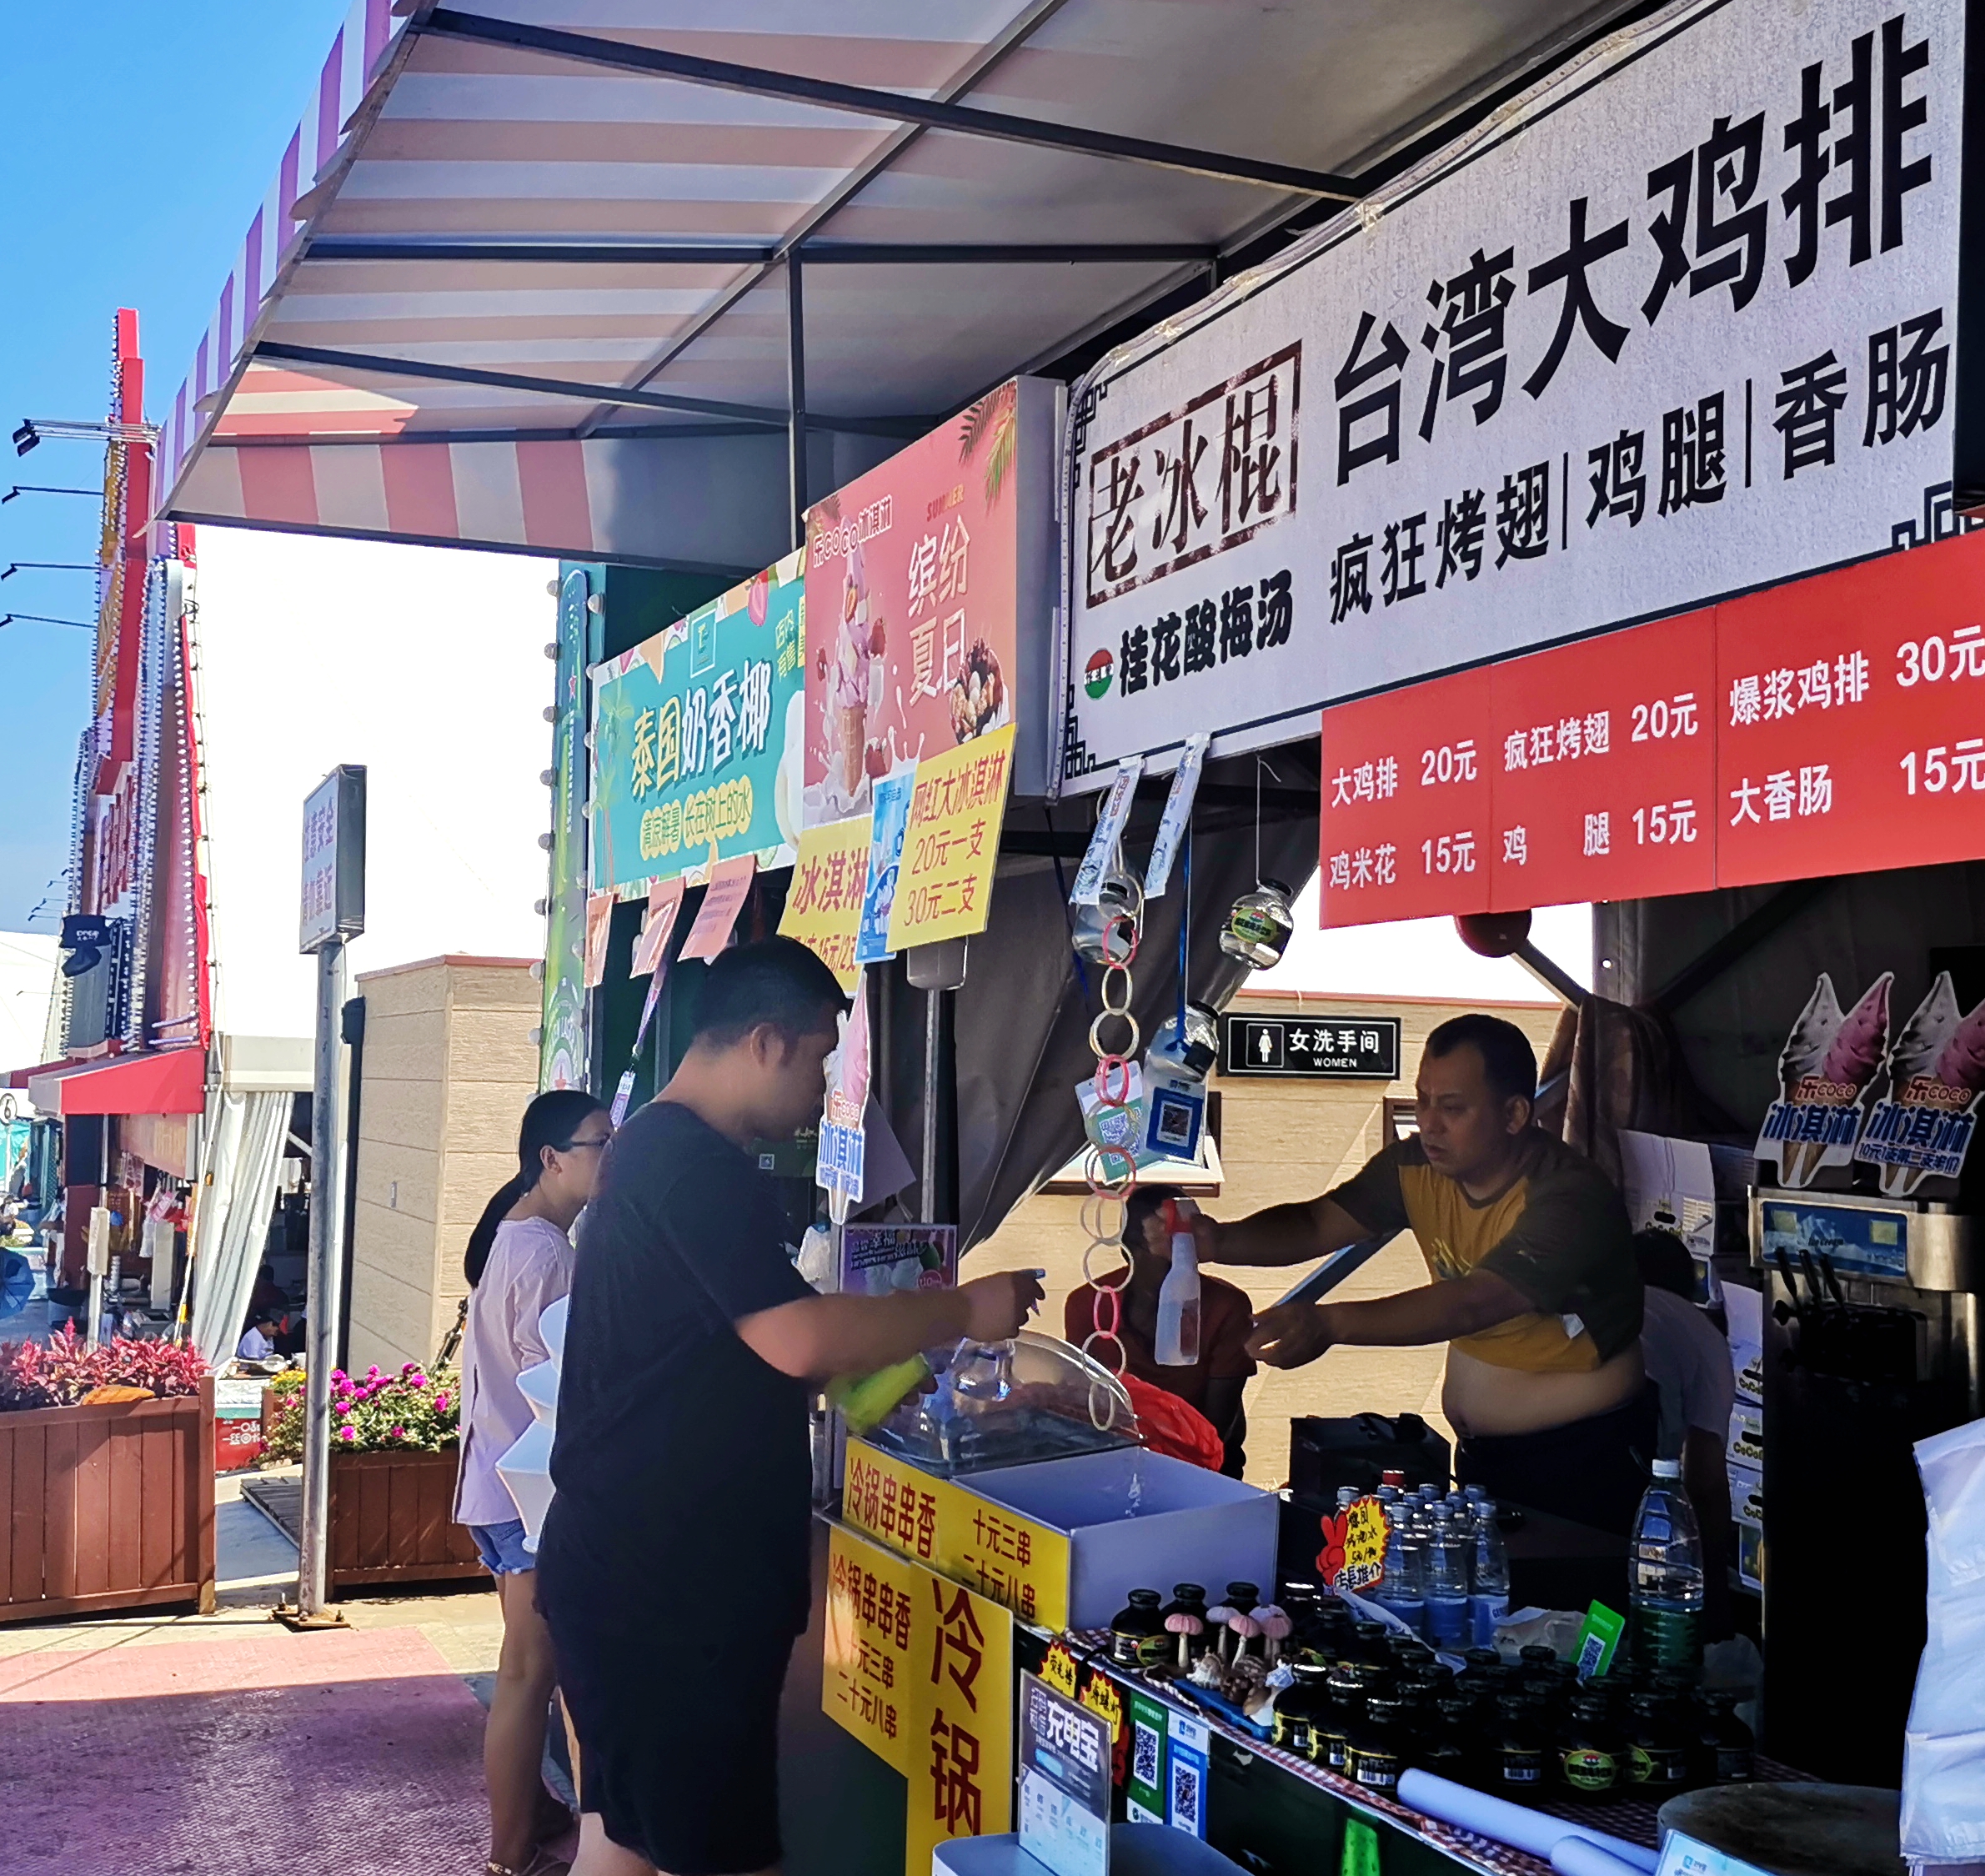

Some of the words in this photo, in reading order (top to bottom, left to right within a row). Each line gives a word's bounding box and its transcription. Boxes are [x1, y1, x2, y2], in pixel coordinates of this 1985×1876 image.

[1333, 13, 1932, 487] 台湾大鸡排
[1091, 373, 1281, 584] 老冰棍
[1330, 461, 1549, 623] 疯狂烤翅
[1587, 392, 1725, 529] 鸡腿
[1773, 308, 1949, 479] 香肠
[908, 514, 970, 618] 缤纷
[910, 608, 965, 708] 夏日
[1118, 569, 1292, 697] 桂花酸梅汤
[1729, 650, 1869, 727] 爆浆鸡排
[1896, 625, 1985, 688] 30元
[631, 660, 771, 798] 泰国奶香椰
[1504, 711, 1610, 772] 疯狂烤翅
[1631, 692, 1698, 743] 20元
[909, 749, 1006, 831] 网红大冰淇淋
[1331, 757, 1398, 807] 大鸡排
[1421, 740, 1477, 786] 20元
[1729, 763, 1832, 827] 大香肠
[1899, 738, 1985, 796] 15元
[911, 818, 987, 875] 20元一支
[1632, 799, 1697, 847] 15元
[792, 846, 869, 915] 冰淇淋
[1329, 844, 1396, 890] 鸡米花
[1422, 831, 1476, 875] 15元
[904, 874, 978, 927] 30元二支
[1289, 1028, 1380, 1054] 女洗手间
[1312, 1057, 1357, 1068] WOMEN
[819, 1121, 862, 1177] 冰淇淋
[1762, 1101, 1861, 1145] 冰淇淋
[1864, 1101, 1974, 1154] 冰淇淋
[847, 1457, 936, 1559] 冷锅串串香
[973, 1508, 1031, 1568] 十元三串
[833, 1554, 911, 1651] 冷锅串串香
[963, 1553, 1037, 1622] 二十元八串
[837, 1671, 898, 1741] 二十元八串
[930, 1578, 985, 1836] 冷锅
[1046, 1700, 1100, 1772] 充电宝
